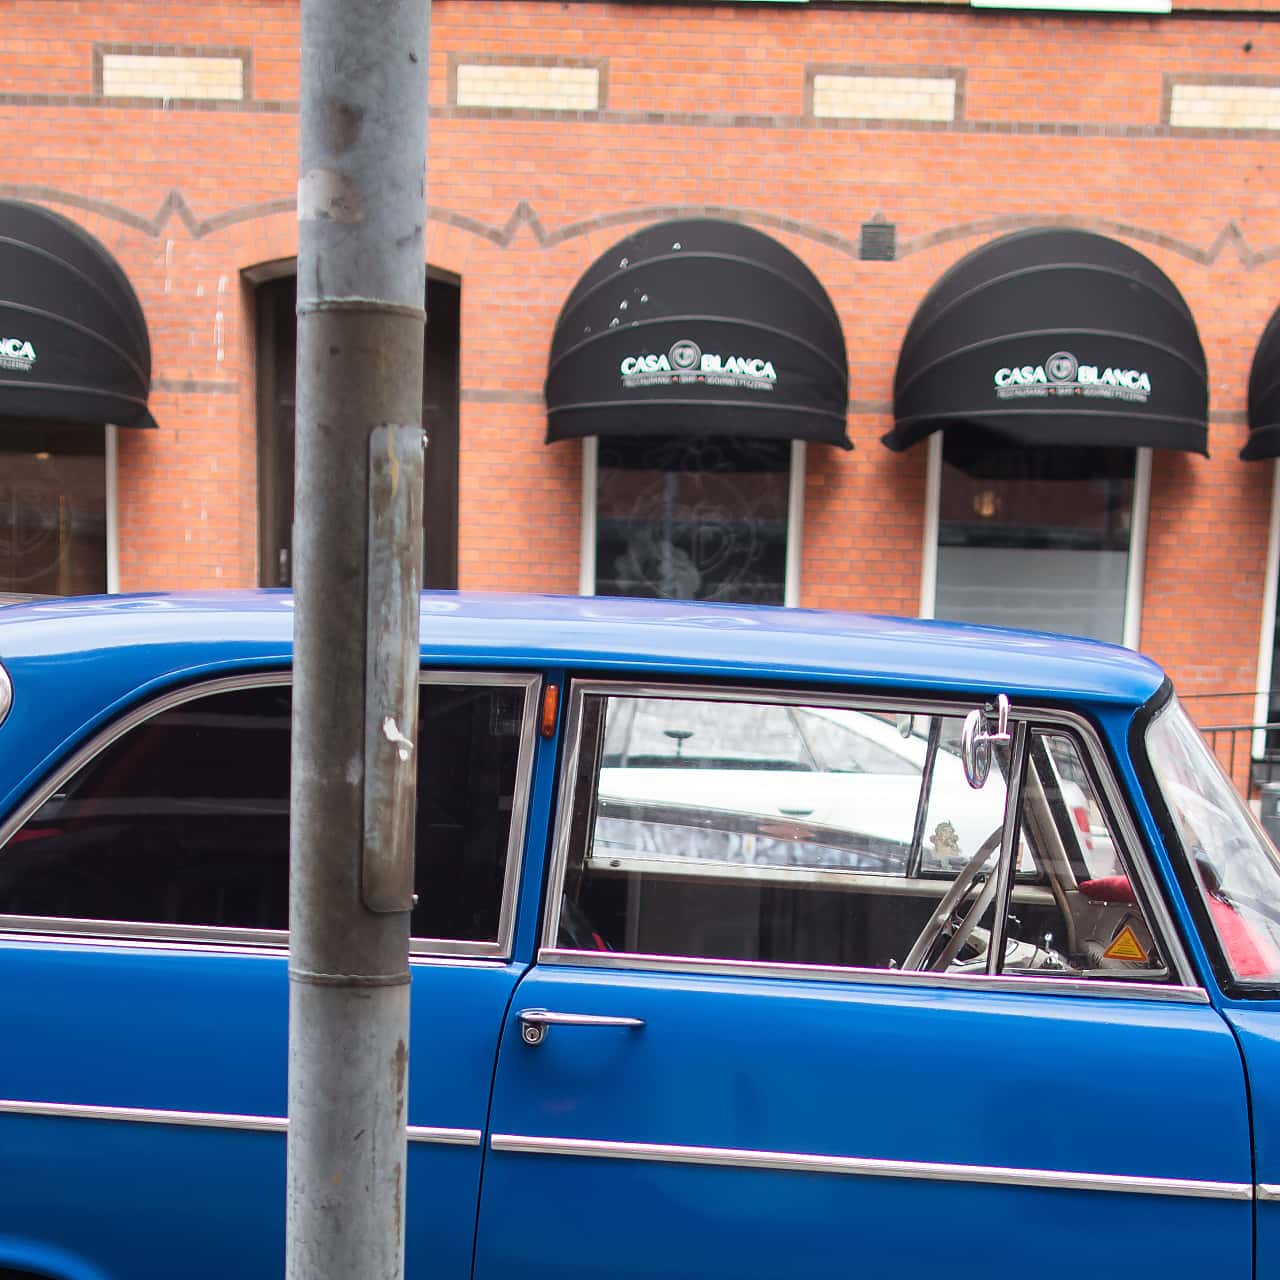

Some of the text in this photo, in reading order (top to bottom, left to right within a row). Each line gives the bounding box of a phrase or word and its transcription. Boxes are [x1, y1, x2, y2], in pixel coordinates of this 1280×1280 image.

[621, 354, 671, 375] CASA
[701, 354, 777, 379] BLANCA
[994, 366, 1047, 387] CASA
[1077, 365, 1151, 392] BLANCA
